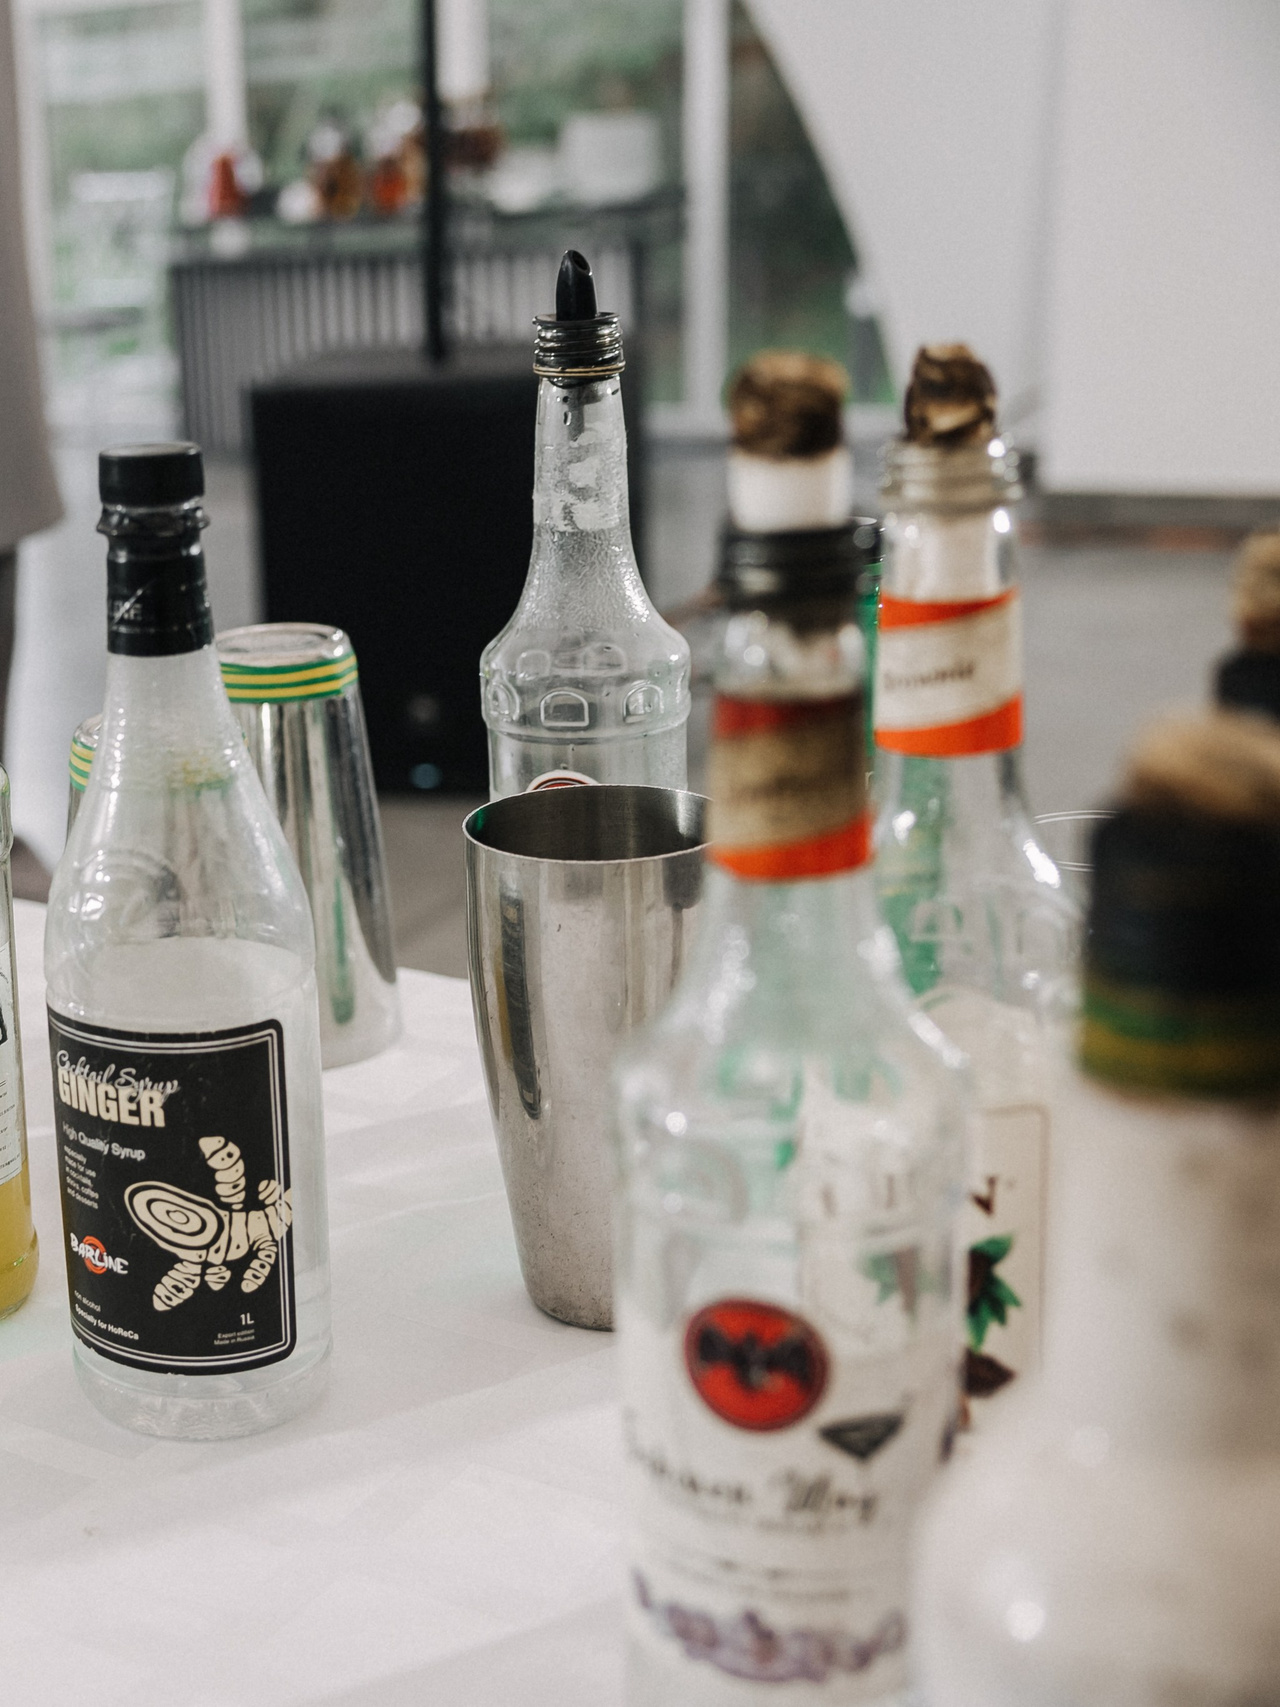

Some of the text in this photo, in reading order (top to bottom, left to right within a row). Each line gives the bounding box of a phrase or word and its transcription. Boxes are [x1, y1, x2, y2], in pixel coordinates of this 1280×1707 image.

[57, 1050, 181, 1105] Cocktail Syrup
[58, 1068, 166, 1128] GINGER
[78, 1131, 109, 1155] Quality
[111, 1142, 146, 1161] Syrup
[107, 1322, 140, 1341] HoReCa
[240, 1312, 255, 1325] 1L
